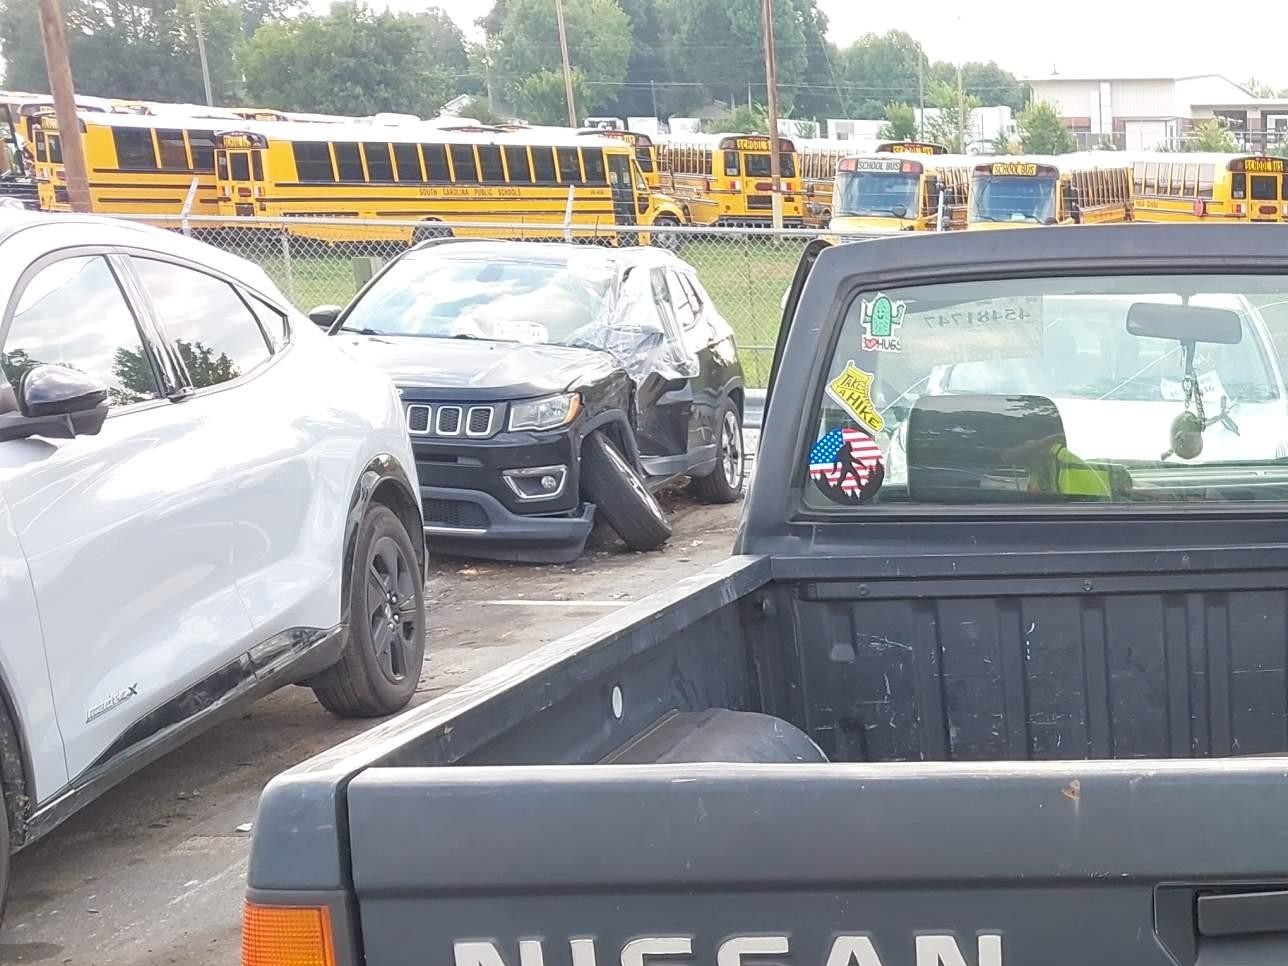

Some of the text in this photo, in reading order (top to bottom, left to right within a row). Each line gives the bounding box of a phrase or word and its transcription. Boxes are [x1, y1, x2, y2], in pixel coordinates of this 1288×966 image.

[858, 160, 900, 170] SCHOOL BUS
[995, 164, 1035, 175] SCHOOL BUS
[1246, 160, 1283, 171] SCHOOL BUS
[419, 188, 521, 196] SOUTH CAROLINA PUBLIC SCHOOLS
[877, 337, 902, 350] HUGS
[840, 373, 864, 390] TAKE
[846, 391, 880, 428] HIKE
